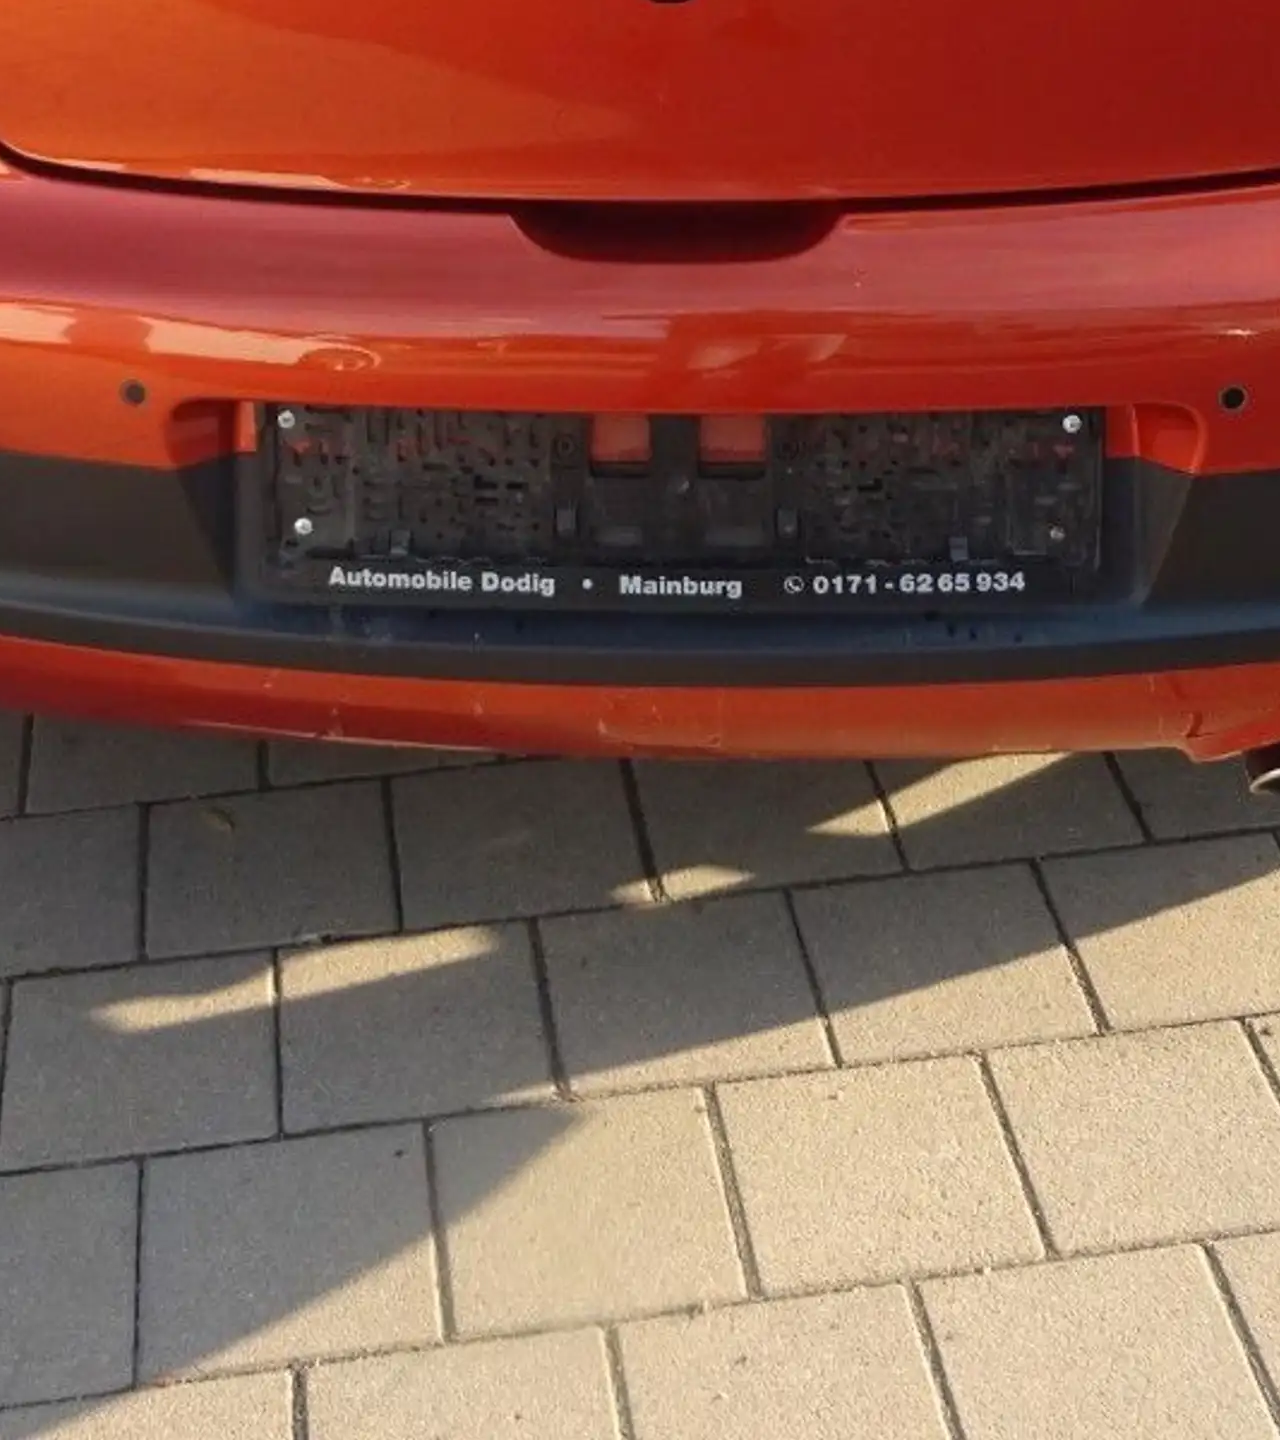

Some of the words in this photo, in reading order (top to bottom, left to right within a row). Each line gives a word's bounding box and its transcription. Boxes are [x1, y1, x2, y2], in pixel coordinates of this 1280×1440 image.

[328, 566, 473, 591] Automobile
[481, 572, 556, 598] Dodig
[619, 575, 743, 599] Mainburg
[813, 574, 877, 594] 0171
[976, 572, 1026, 593] 934
